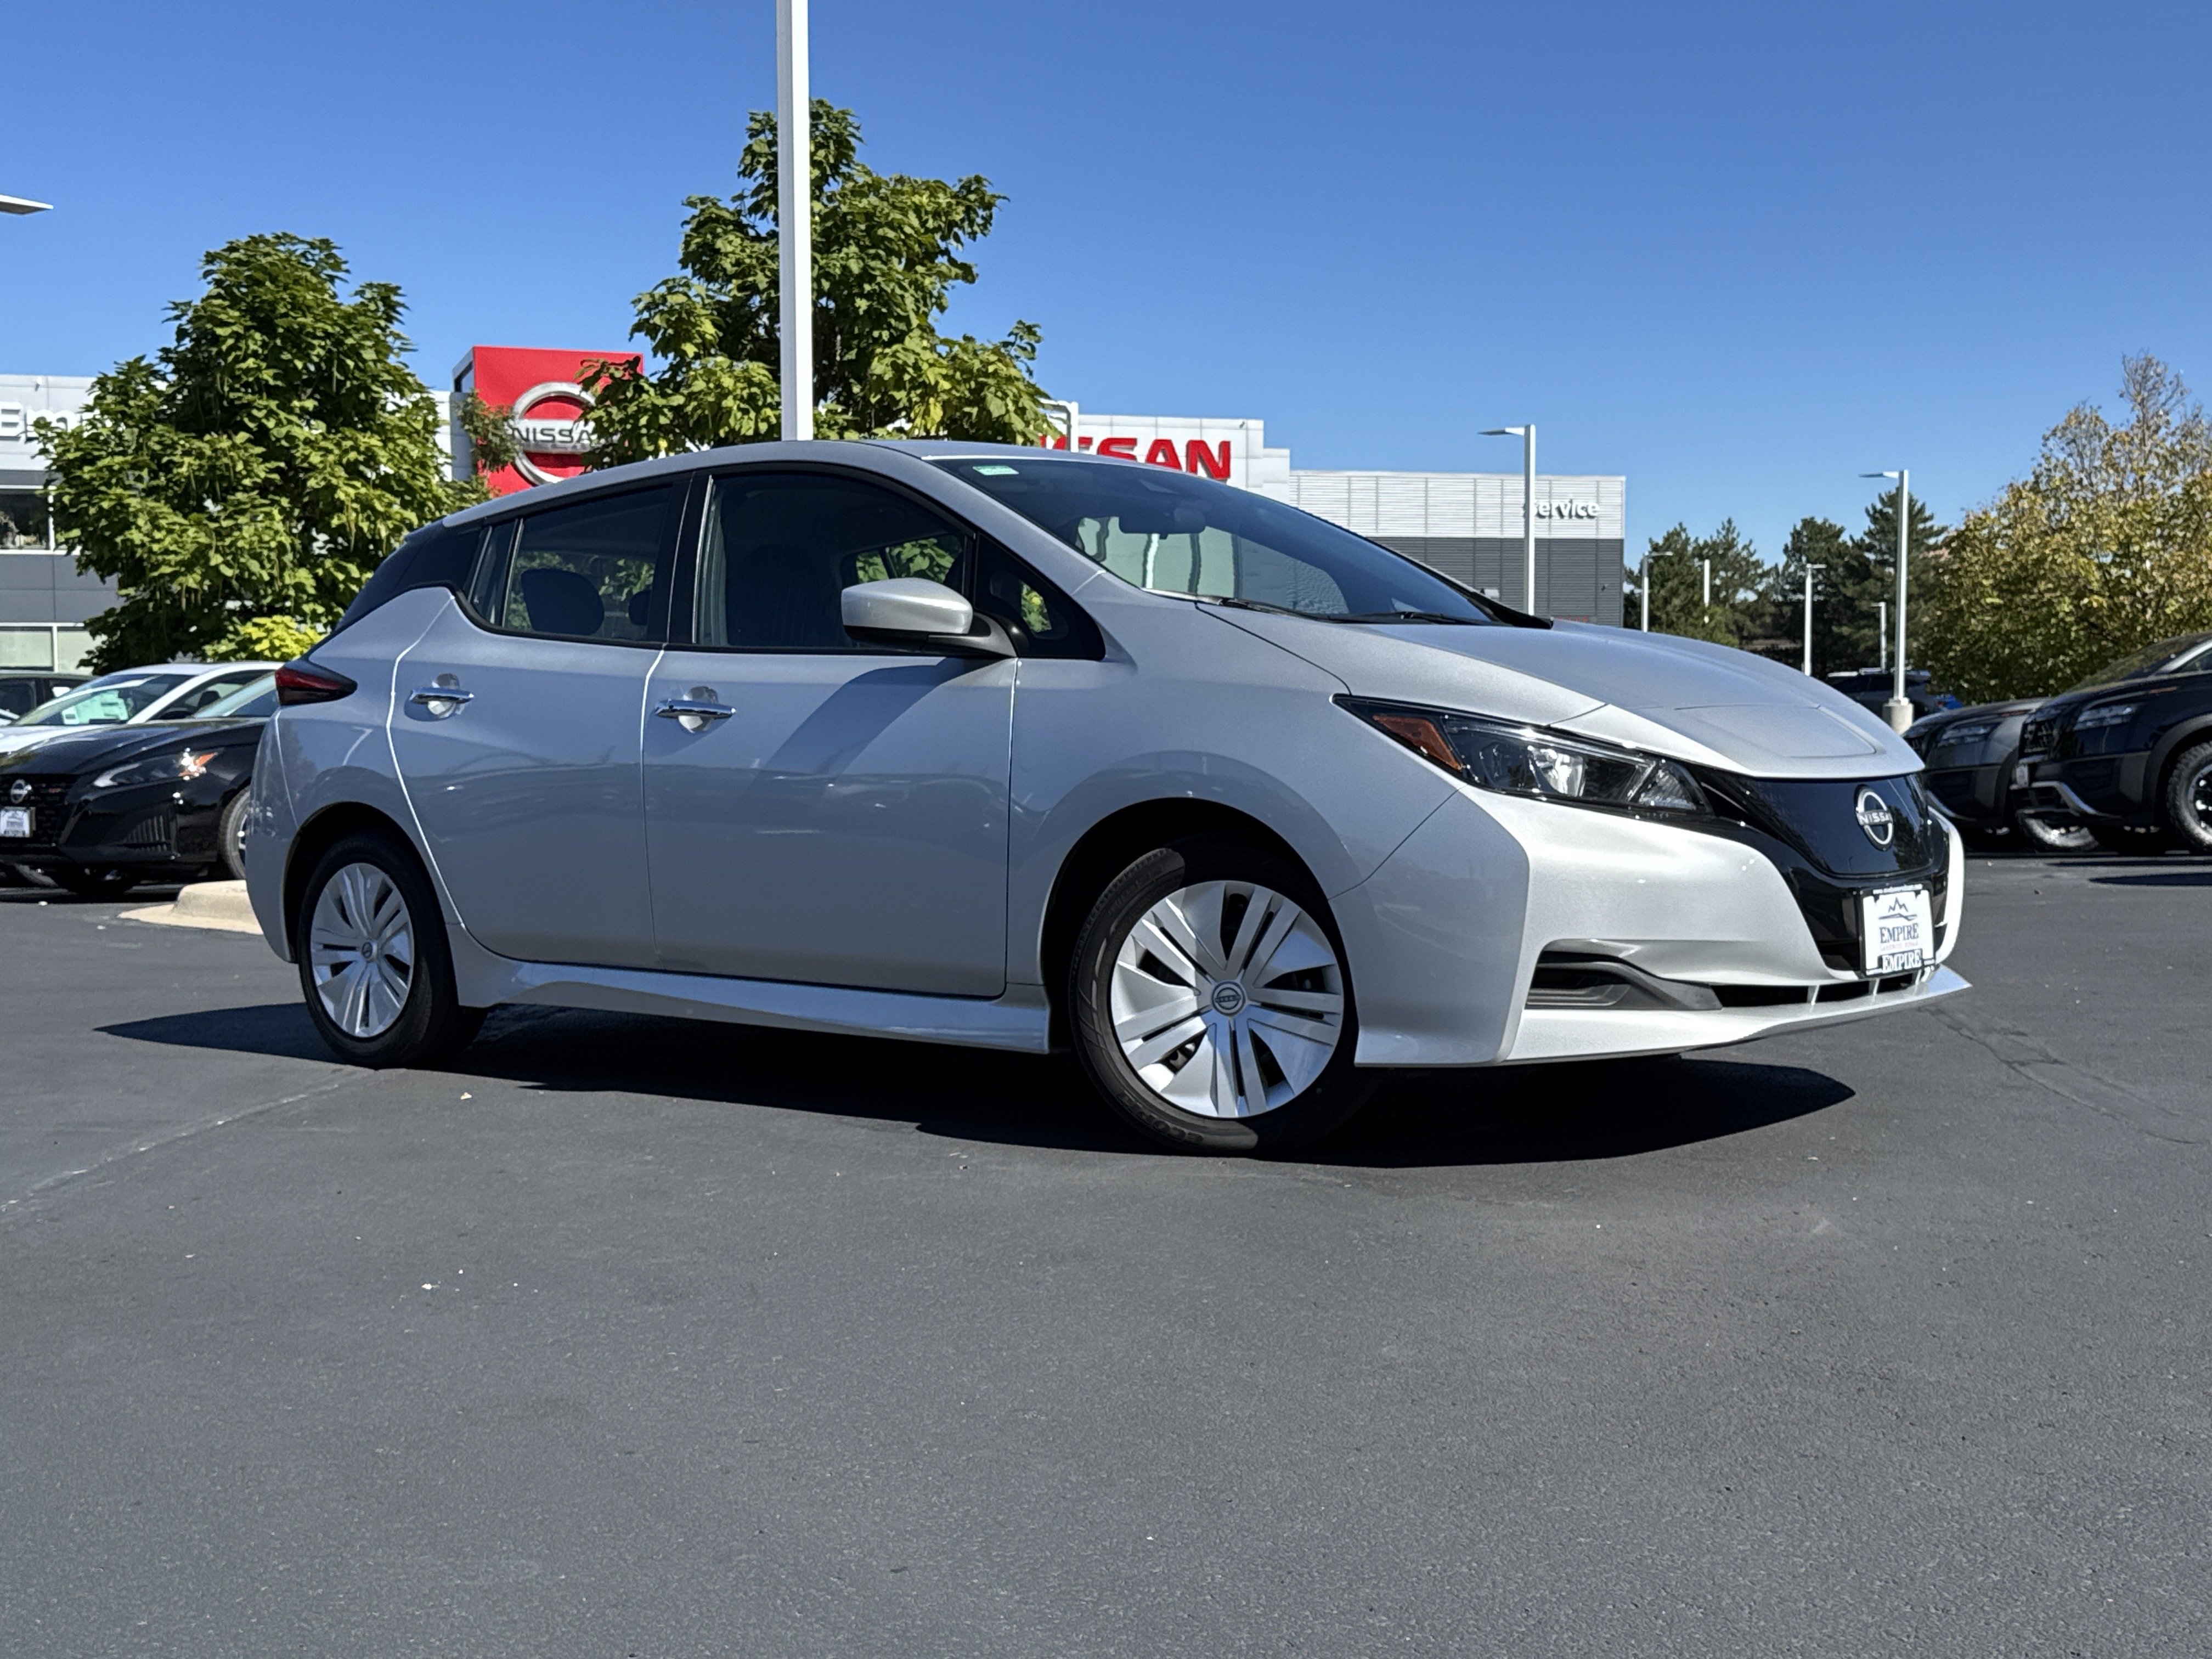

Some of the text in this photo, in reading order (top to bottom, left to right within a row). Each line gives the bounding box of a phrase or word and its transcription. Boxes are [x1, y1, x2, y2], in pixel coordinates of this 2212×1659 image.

[510, 427, 595, 446] NISSA
[1534, 495, 1600, 517] ervice
[1879, 923, 1919, 944] EMPIRE
[1882, 949, 1922, 973] EMPIRE
